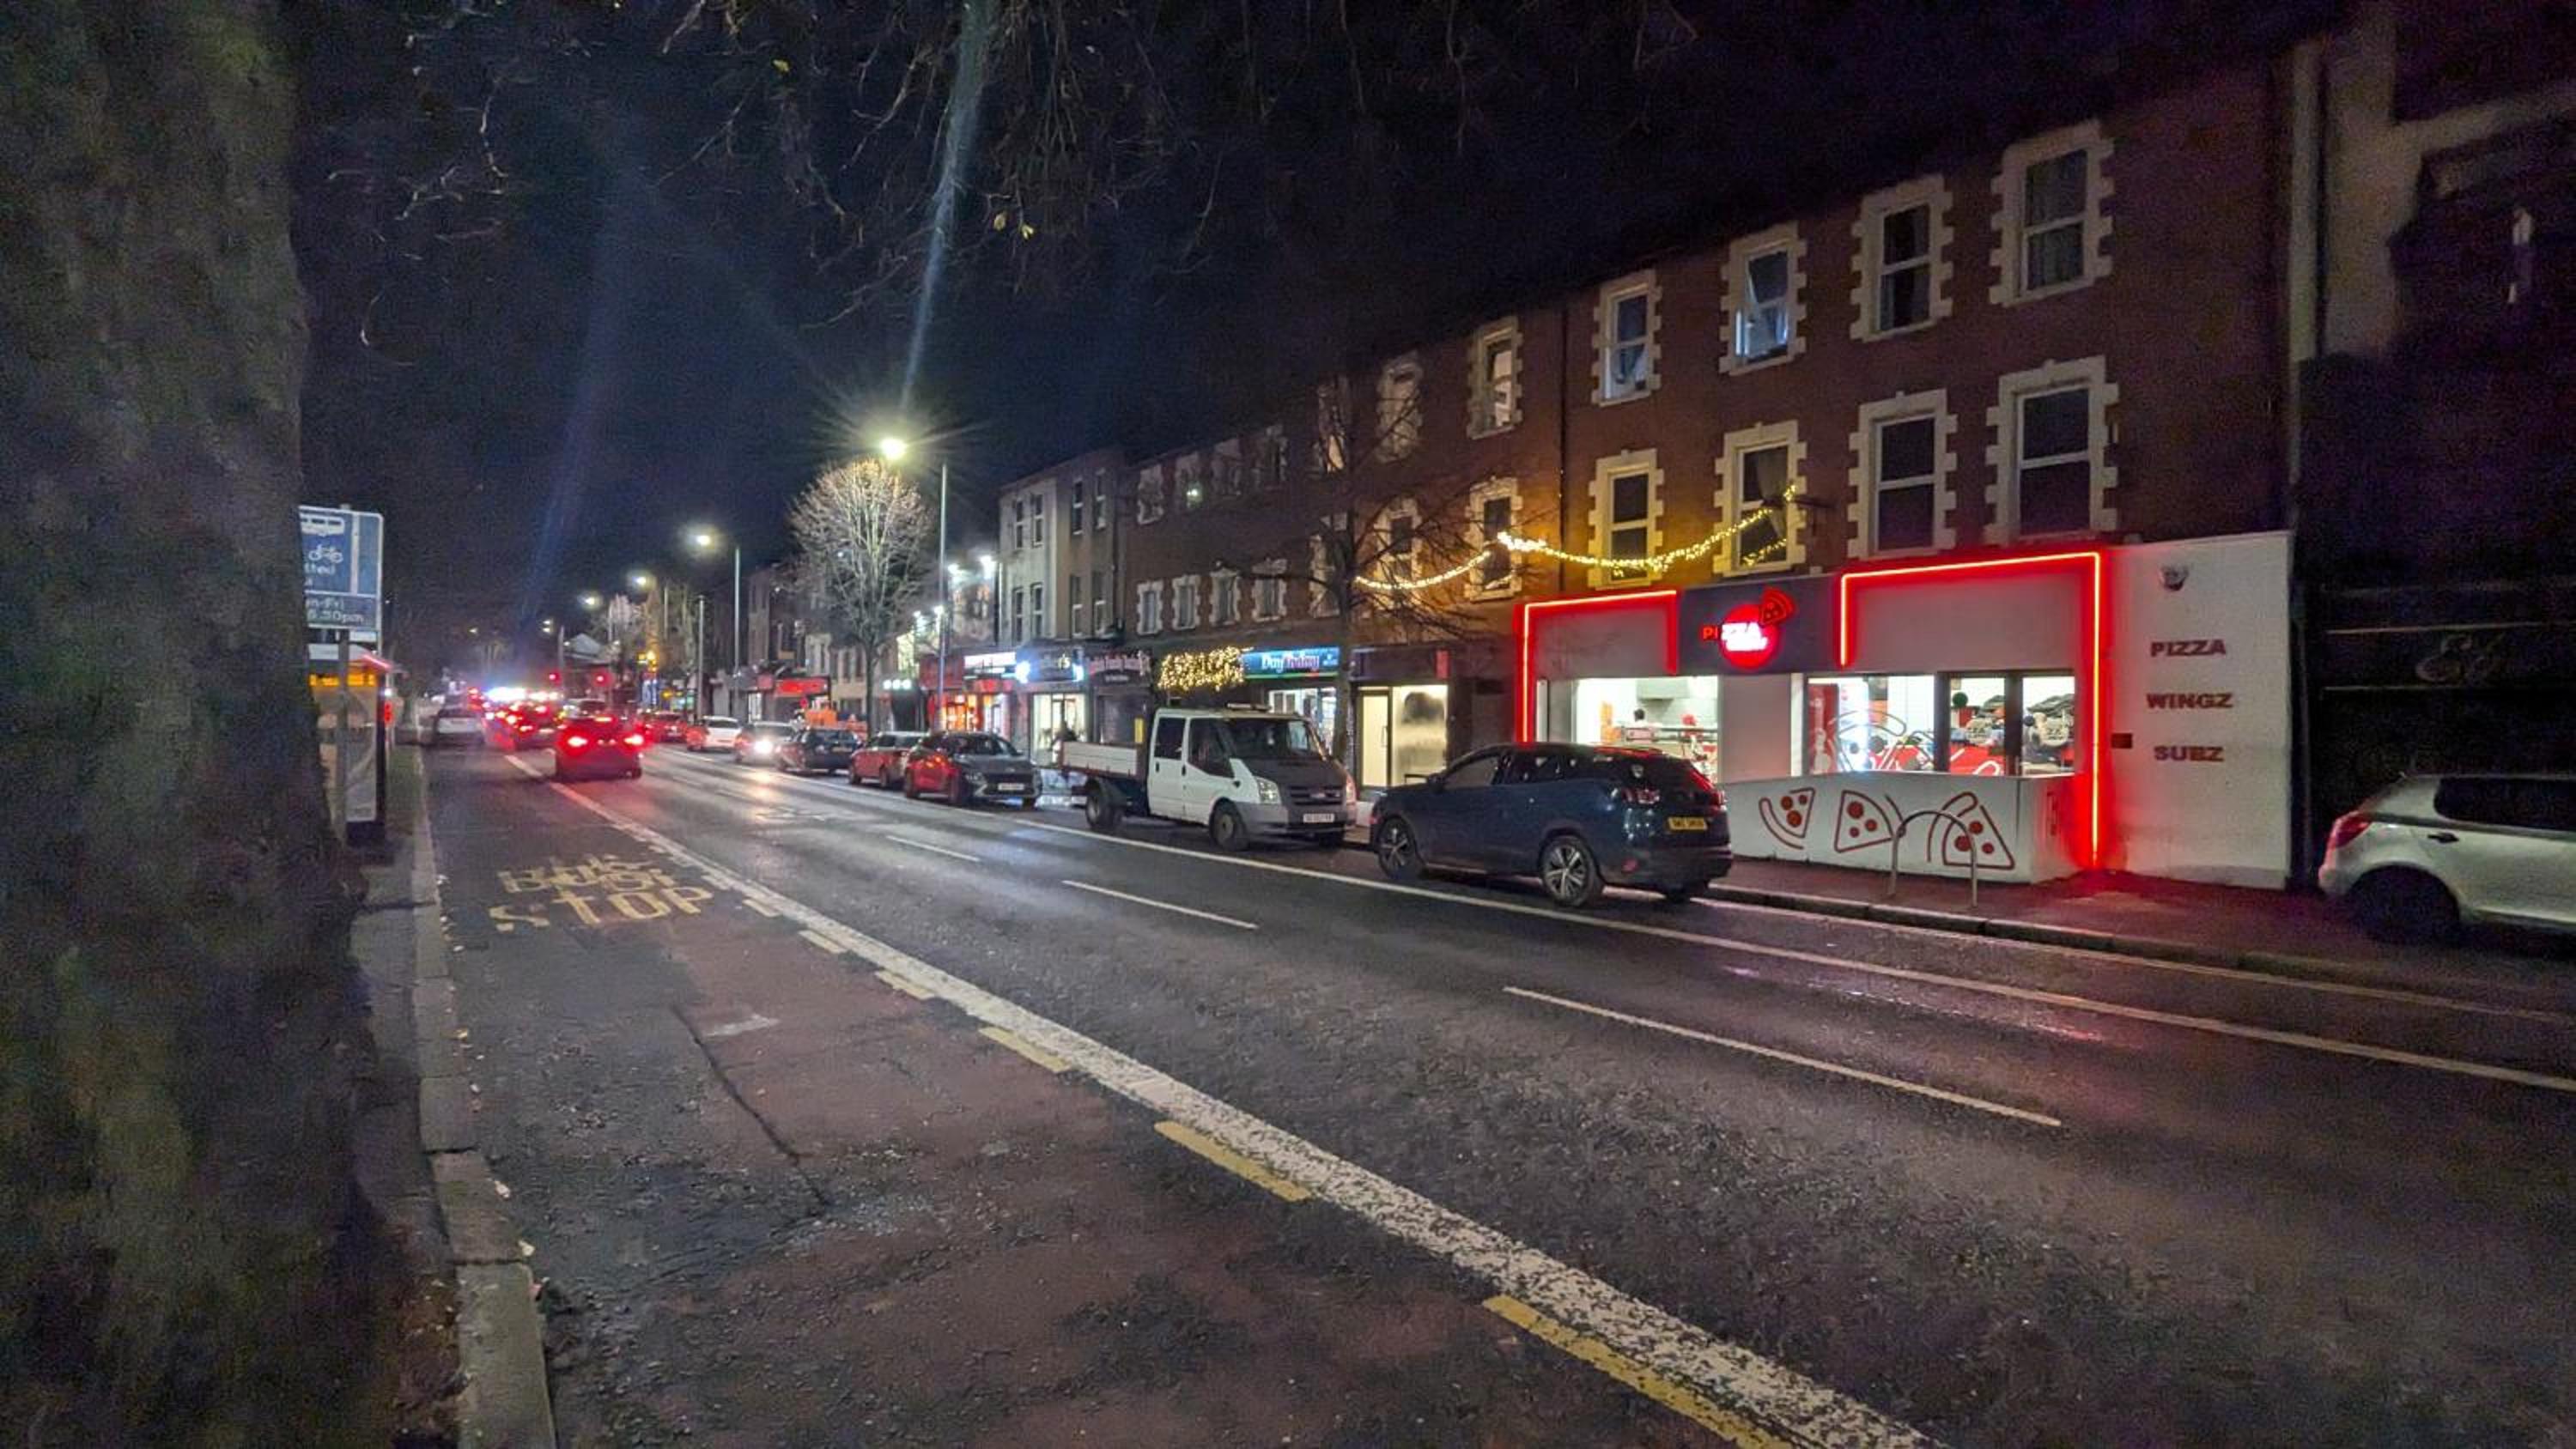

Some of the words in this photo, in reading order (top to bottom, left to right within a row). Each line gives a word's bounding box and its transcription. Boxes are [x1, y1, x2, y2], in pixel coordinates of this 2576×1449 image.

[2150, 639, 2227, 658] PIZZA
[2147, 692, 2234, 709] WINGZ
[2154, 745, 2224, 762] SUBZ
[488, 886, 714, 933] STOP
